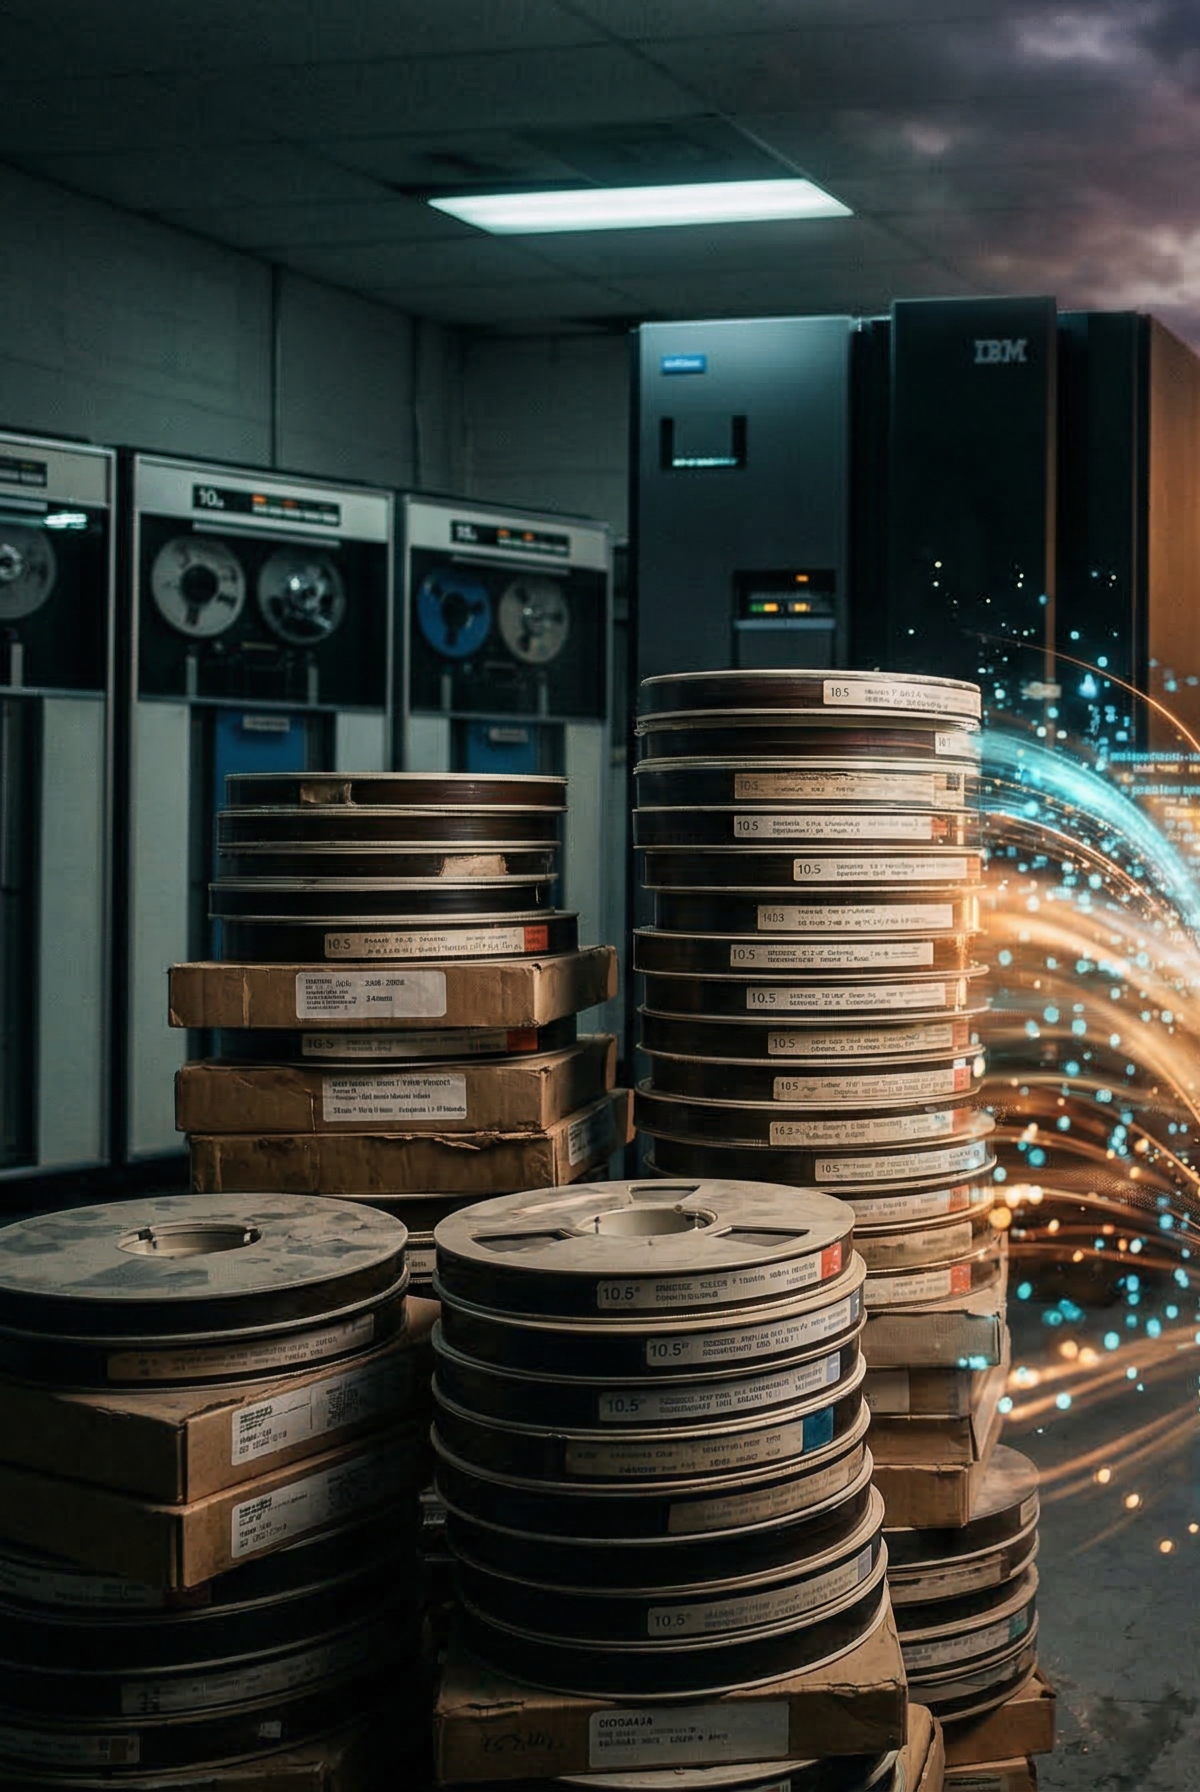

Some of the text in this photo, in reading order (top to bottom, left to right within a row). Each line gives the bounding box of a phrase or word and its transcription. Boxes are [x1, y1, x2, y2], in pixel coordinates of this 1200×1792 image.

[975, 339, 1027, 363] IBM
[797, 864, 822, 875] 10.5
[733, 949, 756, 960] 10.5
[751, 993, 776, 1003] 10.5
[773, 1038, 796, 1048] 10.5
